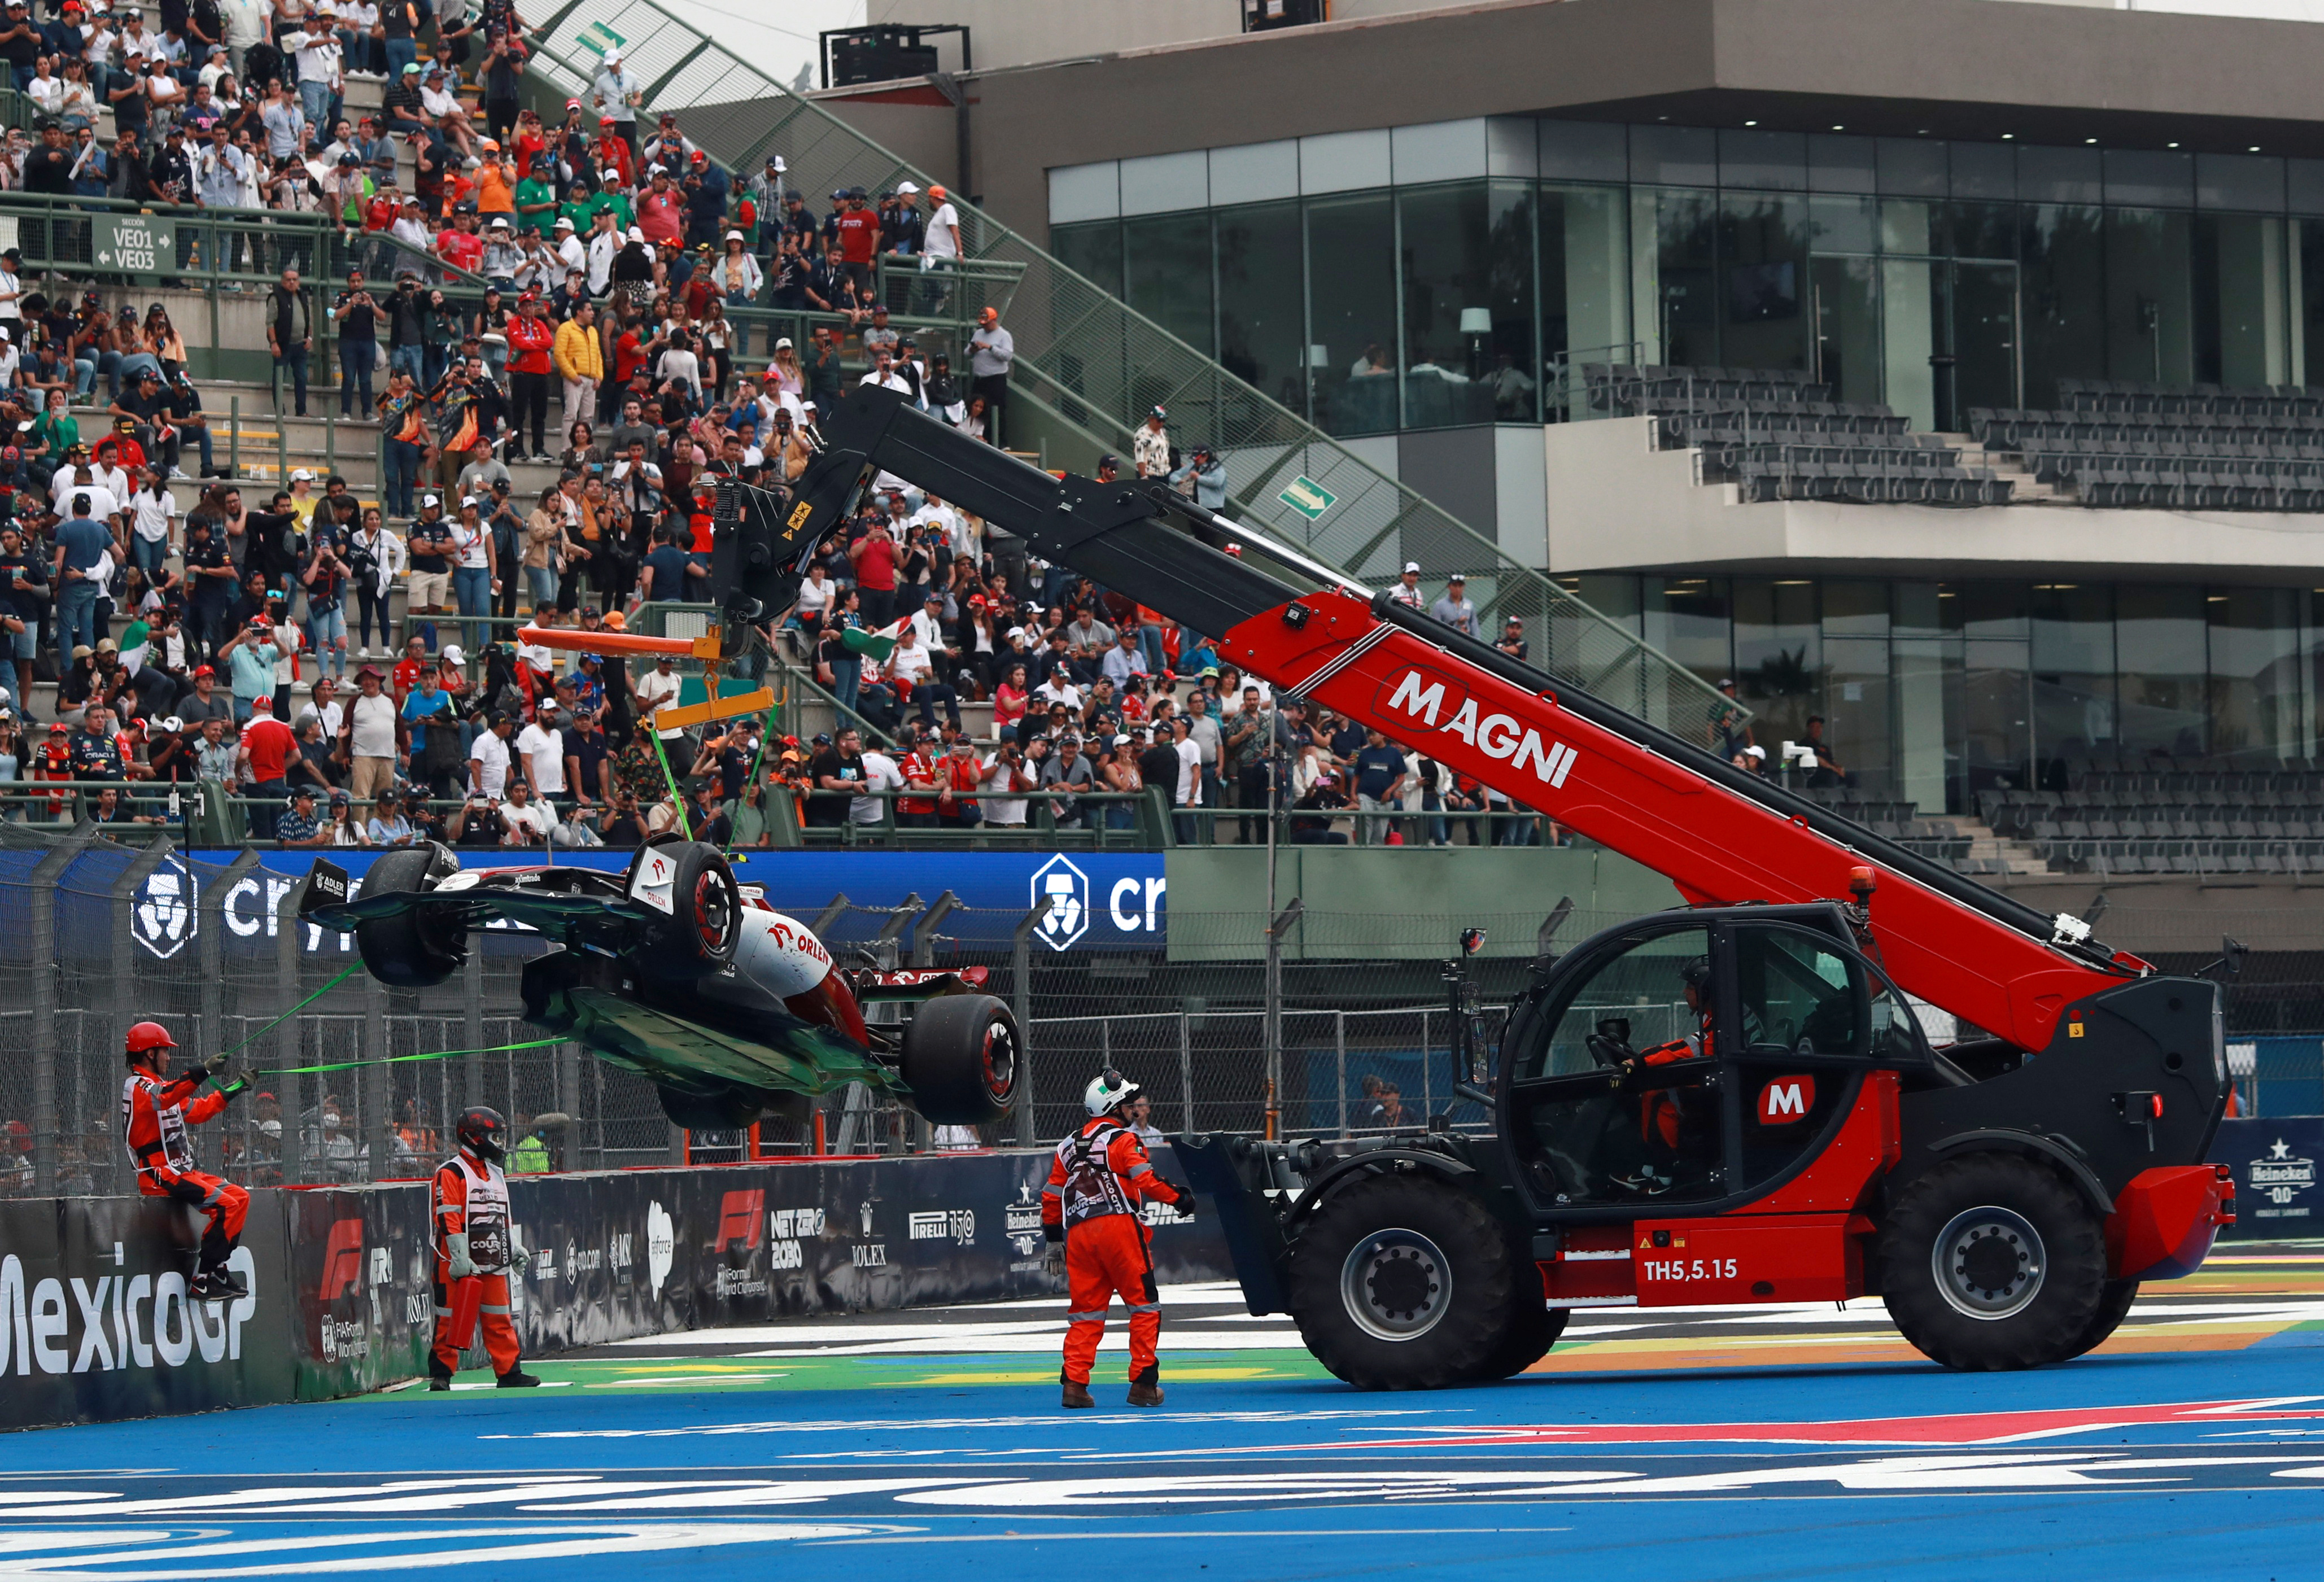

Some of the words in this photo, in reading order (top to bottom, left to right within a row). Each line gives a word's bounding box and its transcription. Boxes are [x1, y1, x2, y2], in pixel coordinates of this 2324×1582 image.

[121, 218, 145, 226] SECCIÓN
[113, 227, 154, 249] VE01
[115, 248, 155, 270] VE03
[1387, 670, 1578, 789] MAGNI
[324, 876, 344, 892] ADLER
[514, 875, 540, 884] aximtrade
[648, 891, 666, 908] ORLEN
[797, 934, 829, 966] ORLEN
[1767, 1083, 1805, 1115] M
[2252, 1166, 2312, 1182] Heineken
[1066, 1192, 1105, 1216] COURSE
[908, 1210, 947, 1240] PIRELLI
[1007, 1211, 1041, 1230] Heineken
[771, 1239, 802, 1270] 2030
[851, 1244, 887, 1268] ROLEX
[1644, 1258, 1737, 1282] TH5,5.15
